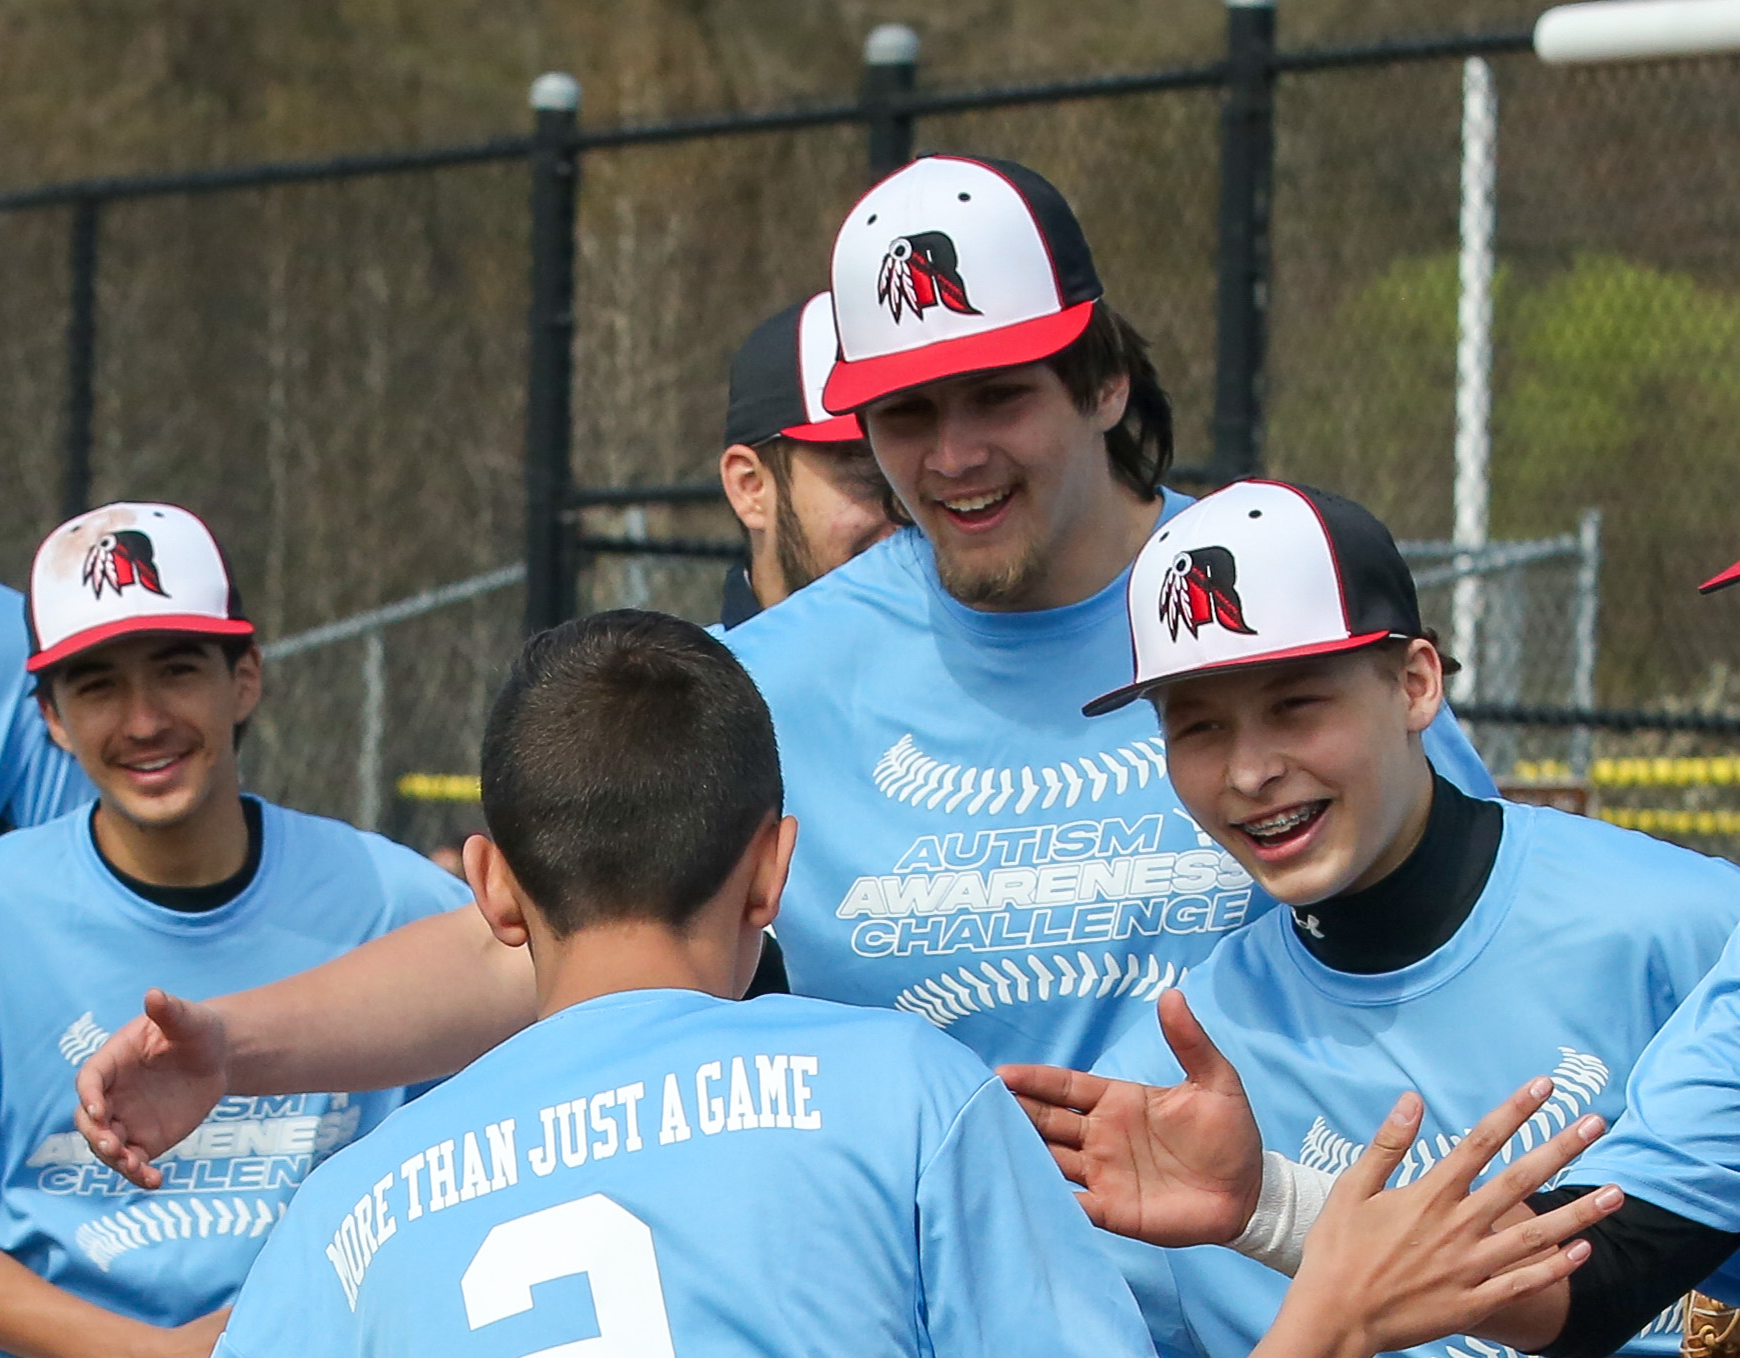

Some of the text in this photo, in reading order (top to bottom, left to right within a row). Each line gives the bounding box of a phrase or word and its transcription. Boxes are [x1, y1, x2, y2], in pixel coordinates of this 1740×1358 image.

[893, 814, 1163, 873] AUTISM
[836, 850, 1254, 919] AWARENESS
[851, 889, 1252, 957] CHALLENGE
[37, 1155, 313, 1196] CHLLEN
[326, 1054, 822, 1312] MORE THAN JUST A GAME
